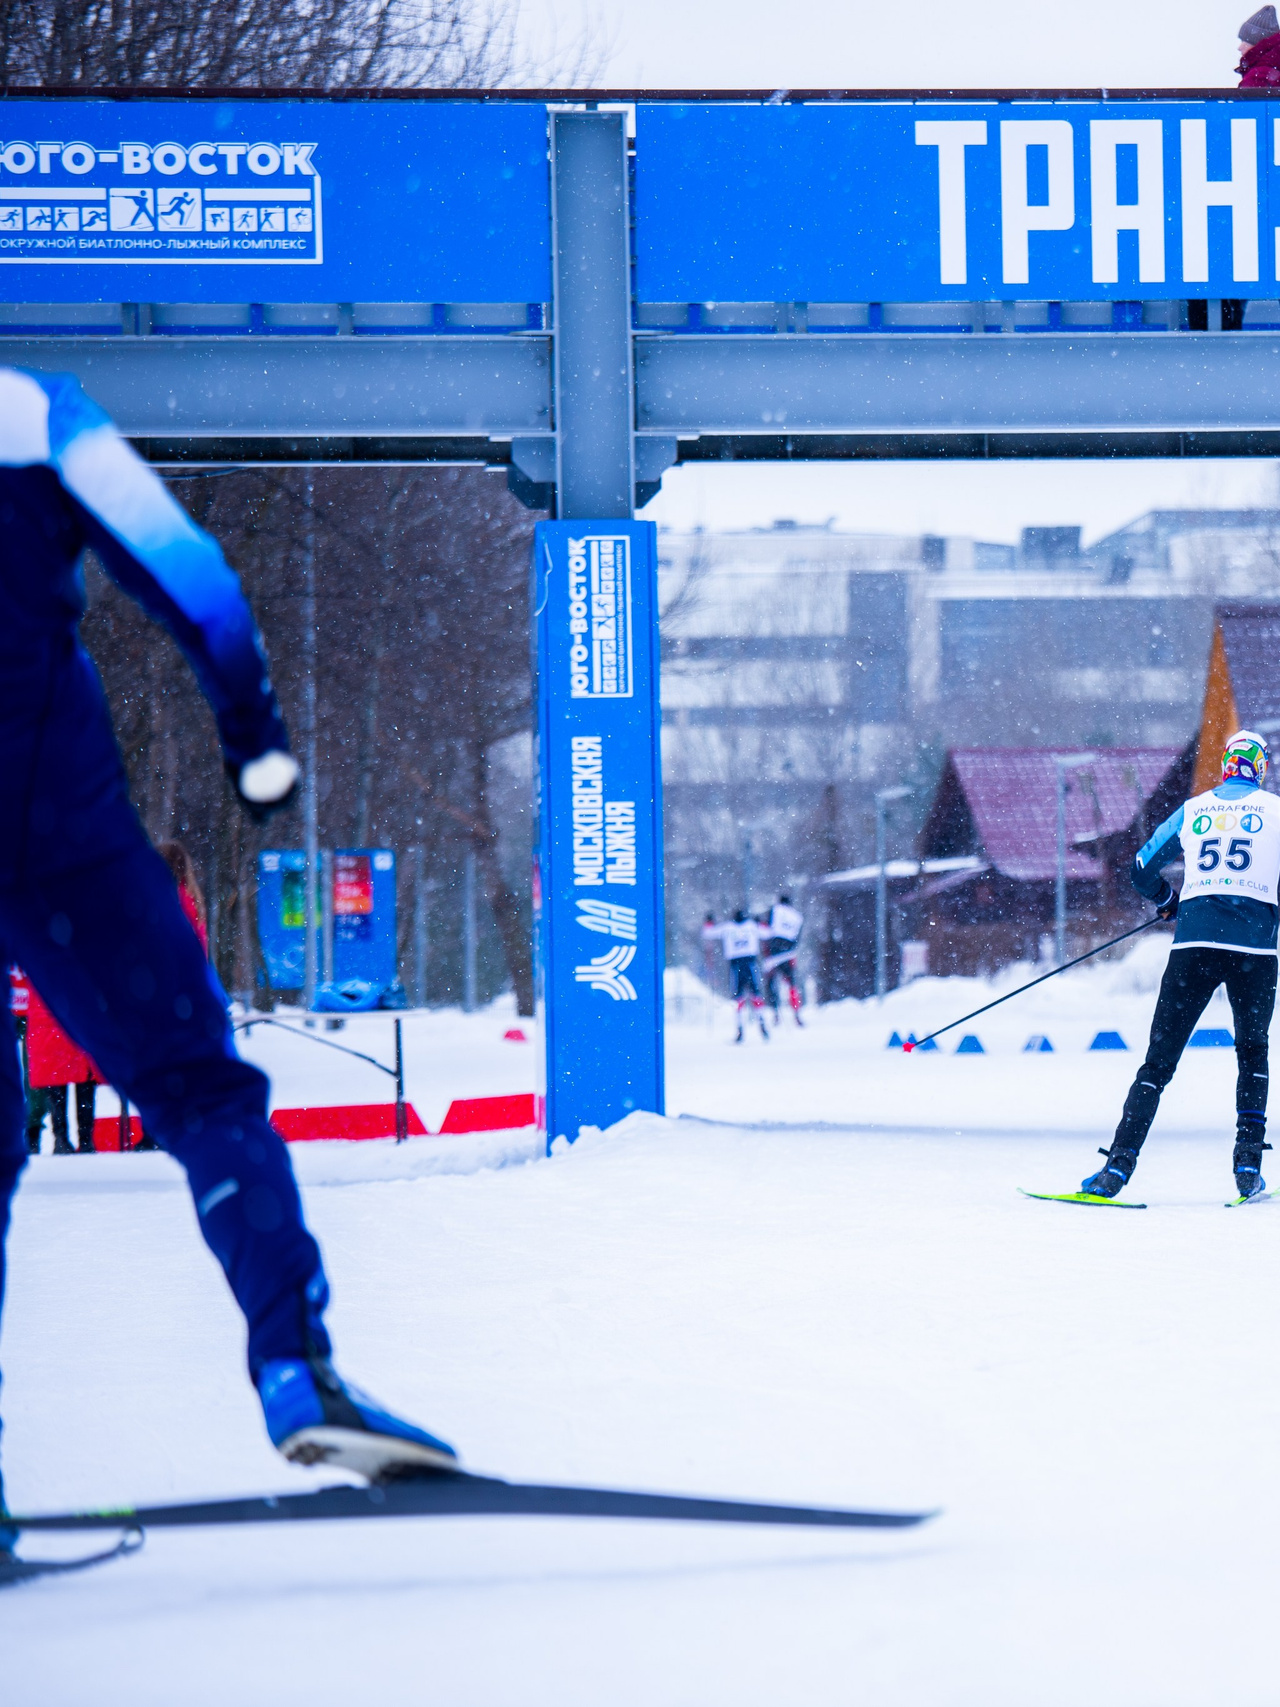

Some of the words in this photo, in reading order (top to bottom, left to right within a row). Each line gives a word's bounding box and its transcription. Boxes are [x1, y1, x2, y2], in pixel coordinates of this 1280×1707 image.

[0, 236, 77, 249] ОКРУЖНОЙ
[79, 236, 231, 250] БИАТЛОННО-ЛЫЖНЫЙ
[233, 239, 307, 250] КОМПЛЕКС
[568, 536, 589, 698] ЮГО-ВОСТОК
[571, 736, 604, 886] МОСКОВСКАЯ
[1193, 804, 1265, 816] VMARAFONE
[605, 801, 637, 886] ЛЫЖНЯ
[1197, 836, 1252, 873] 55
